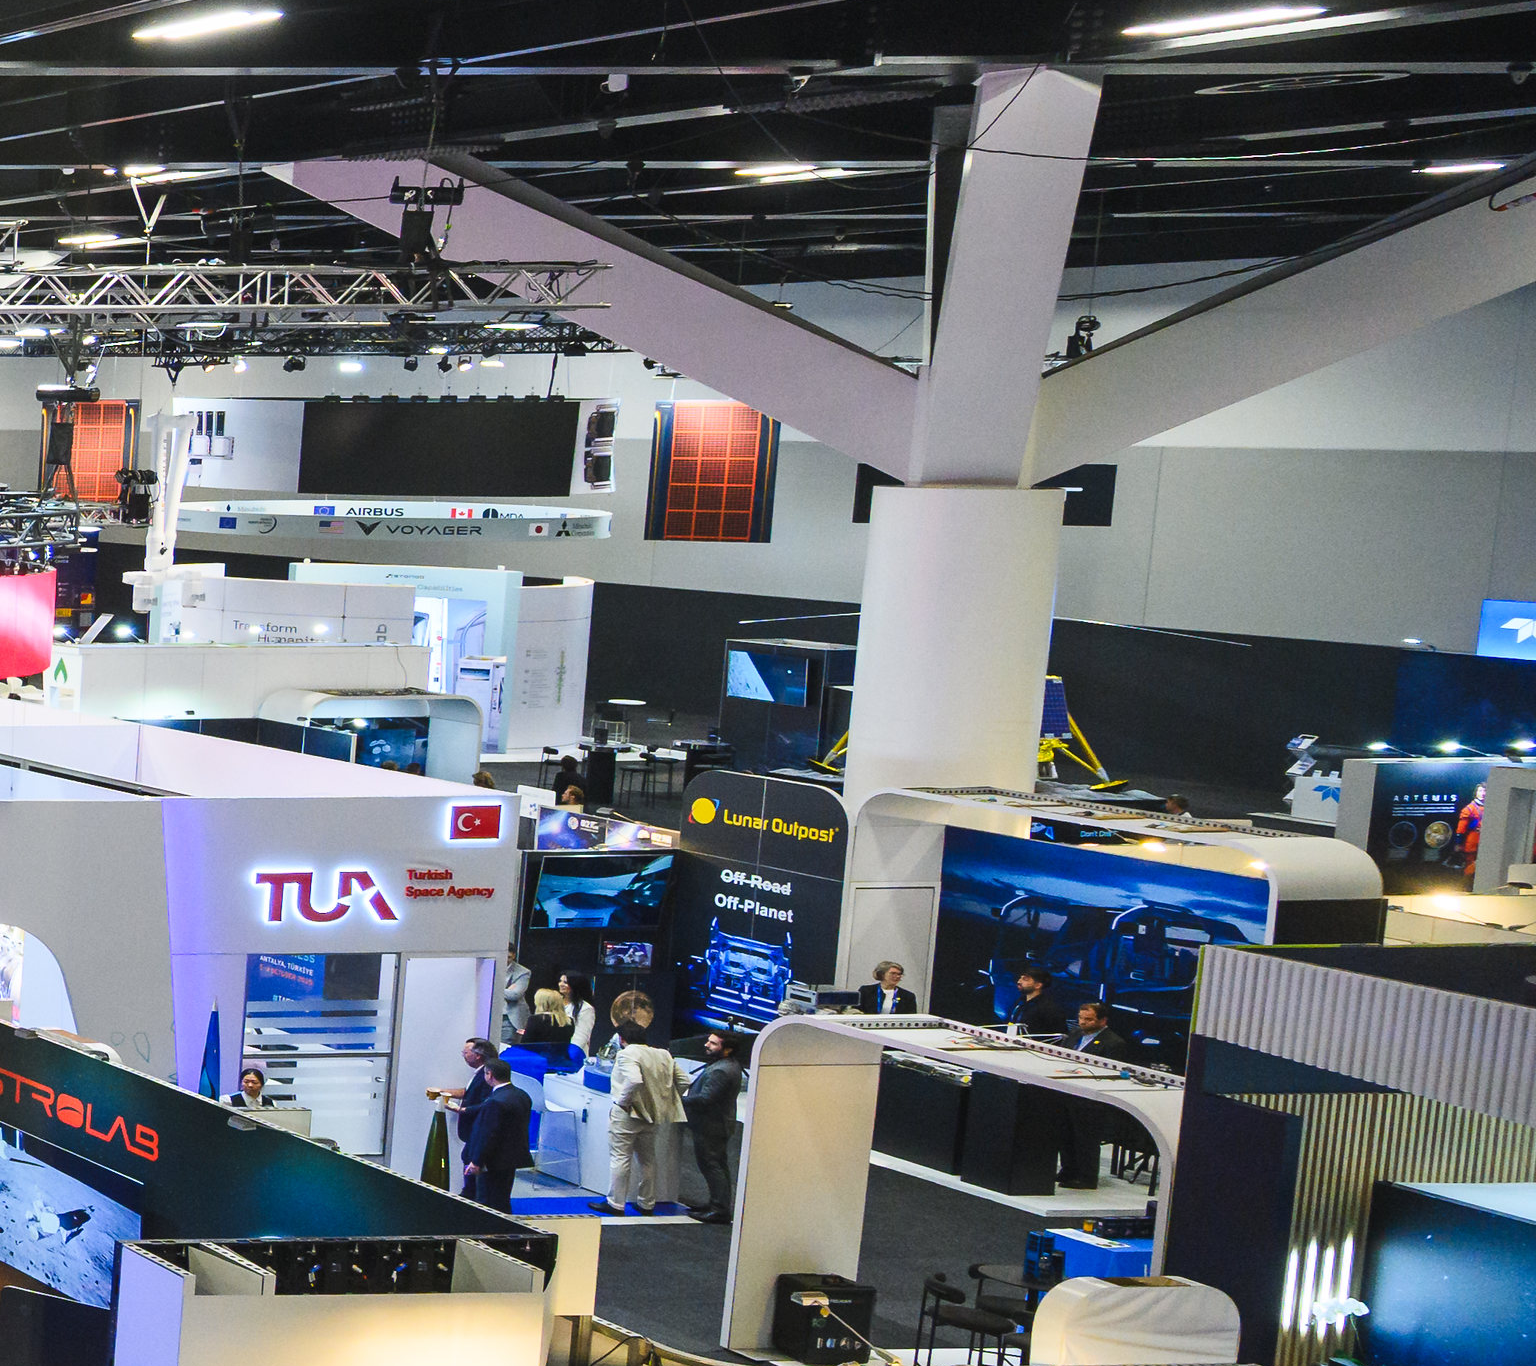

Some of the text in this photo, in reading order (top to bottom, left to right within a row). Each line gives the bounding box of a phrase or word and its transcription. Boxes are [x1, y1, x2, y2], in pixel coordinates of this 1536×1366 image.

[346, 507, 404, 517] AIRBUS
[386, 524, 482, 536] VOYAGER
[724, 809, 835, 843] Lunar Outpost
[406, 869, 453, 881] Turkish
[720, 869, 792, 895] Off-Road
[255, 871, 399, 922] TUA
[405, 885, 494, 899] Space Agency
[714, 893, 794, 923] Off-Planet
